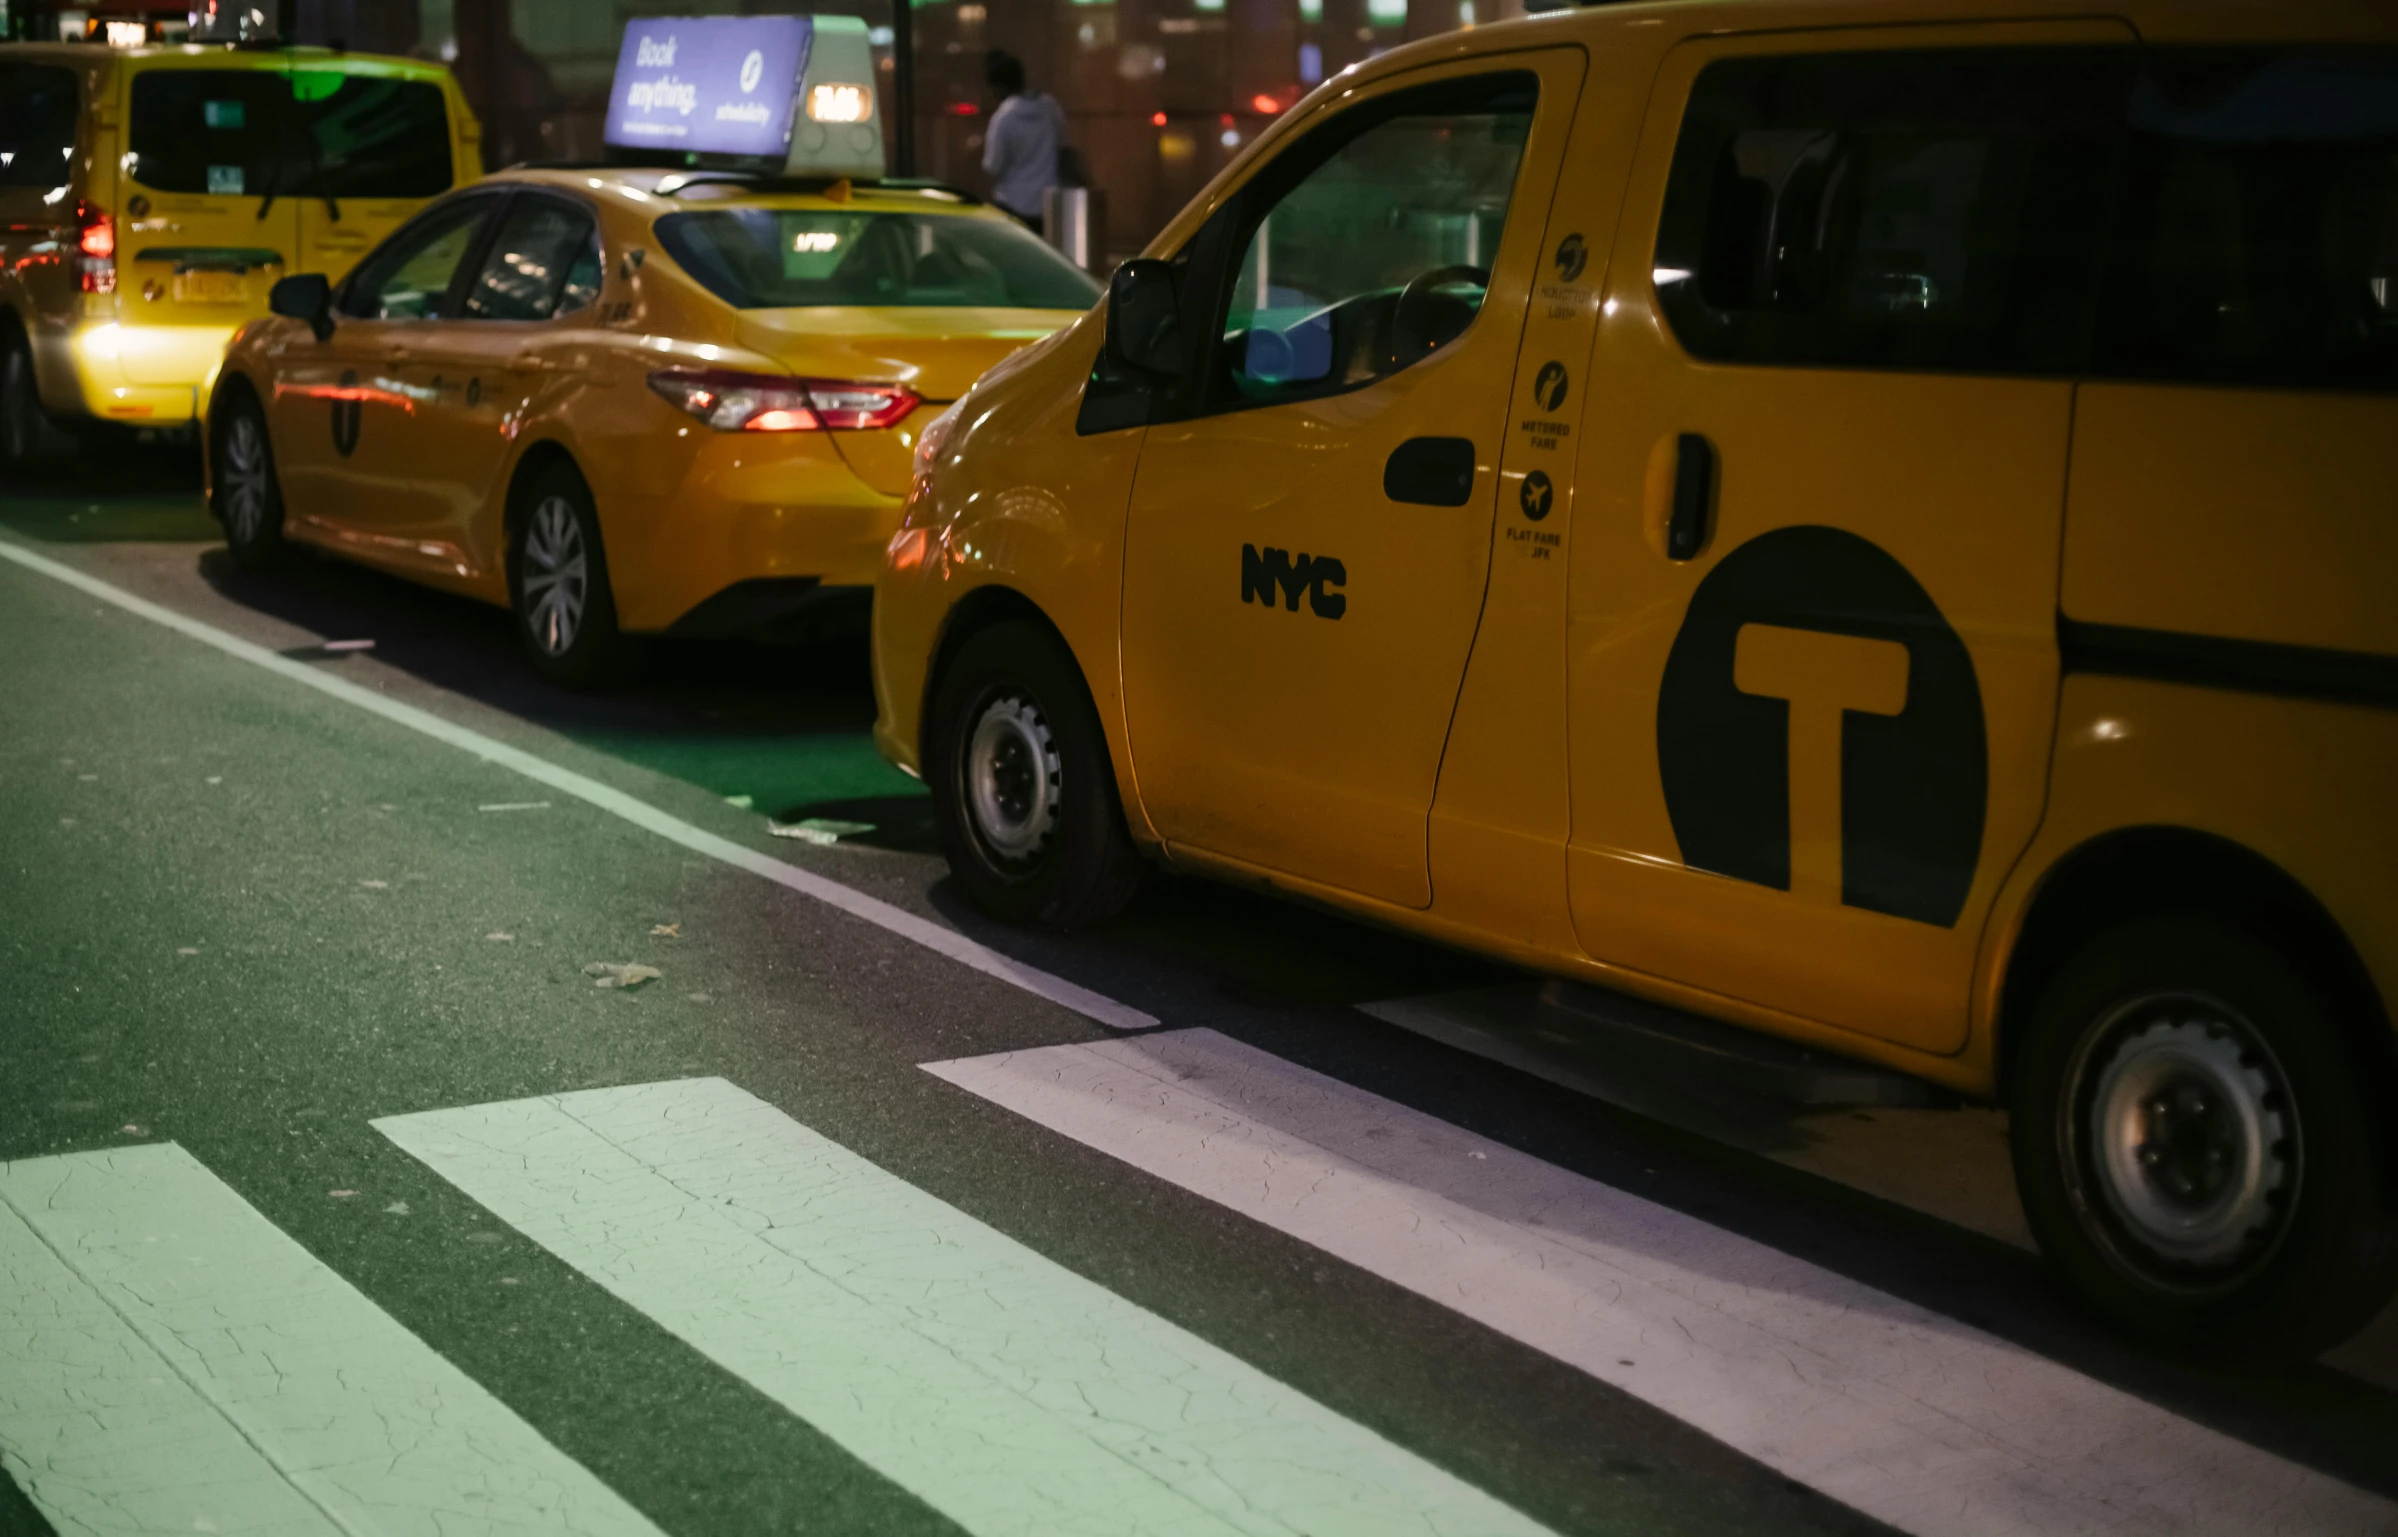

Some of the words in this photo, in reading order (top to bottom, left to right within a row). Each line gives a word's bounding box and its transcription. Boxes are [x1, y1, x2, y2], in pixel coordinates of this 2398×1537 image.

[637, 35, 678, 67] Book
[1548, 304, 1576, 320] LOOP
[1521, 420, 1570, 436] METERED
[1530, 436, 1558, 450] FARE
[1506, 527, 1532, 542] FLAT
[1534, 531, 1561, 546] FARE
[1531, 547, 1551, 560] JFK
[1241, 543, 1347, 620] NYC
[1732, 621, 1911, 906] T
